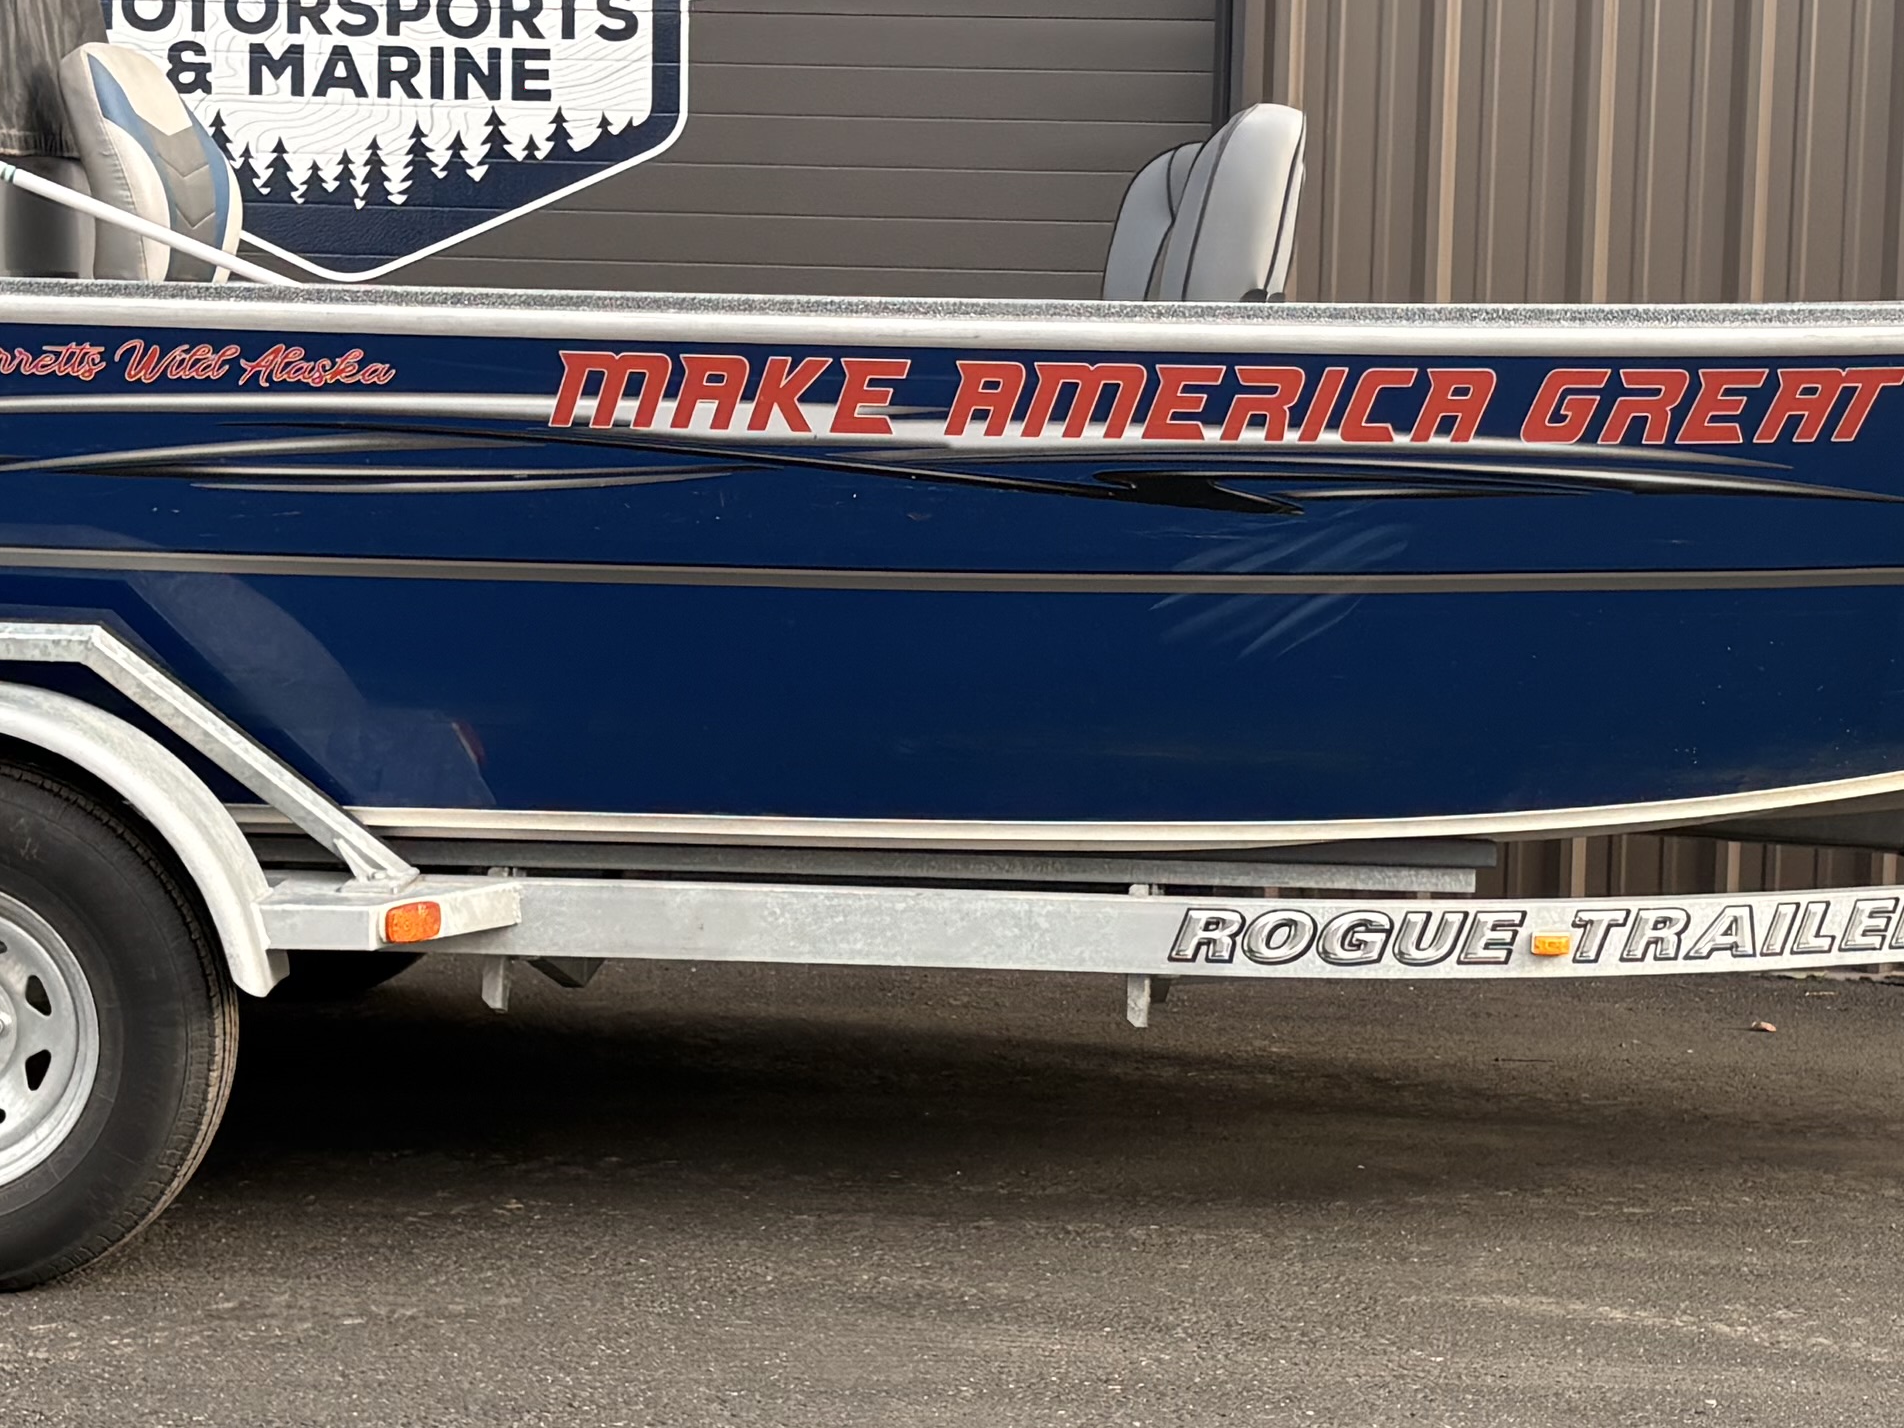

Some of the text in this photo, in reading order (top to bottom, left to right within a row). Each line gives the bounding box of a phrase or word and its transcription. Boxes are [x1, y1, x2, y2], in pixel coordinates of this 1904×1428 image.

[166, 40, 554, 103] & MARINE
[114, 337, 232, 385] Wild
[239, 342, 397, 389] Alaska
[548, 350, 912, 437] MAKE
[943, 359, 1498, 443] AMERICA
[1168, 907, 1526, 966] ROGUE
